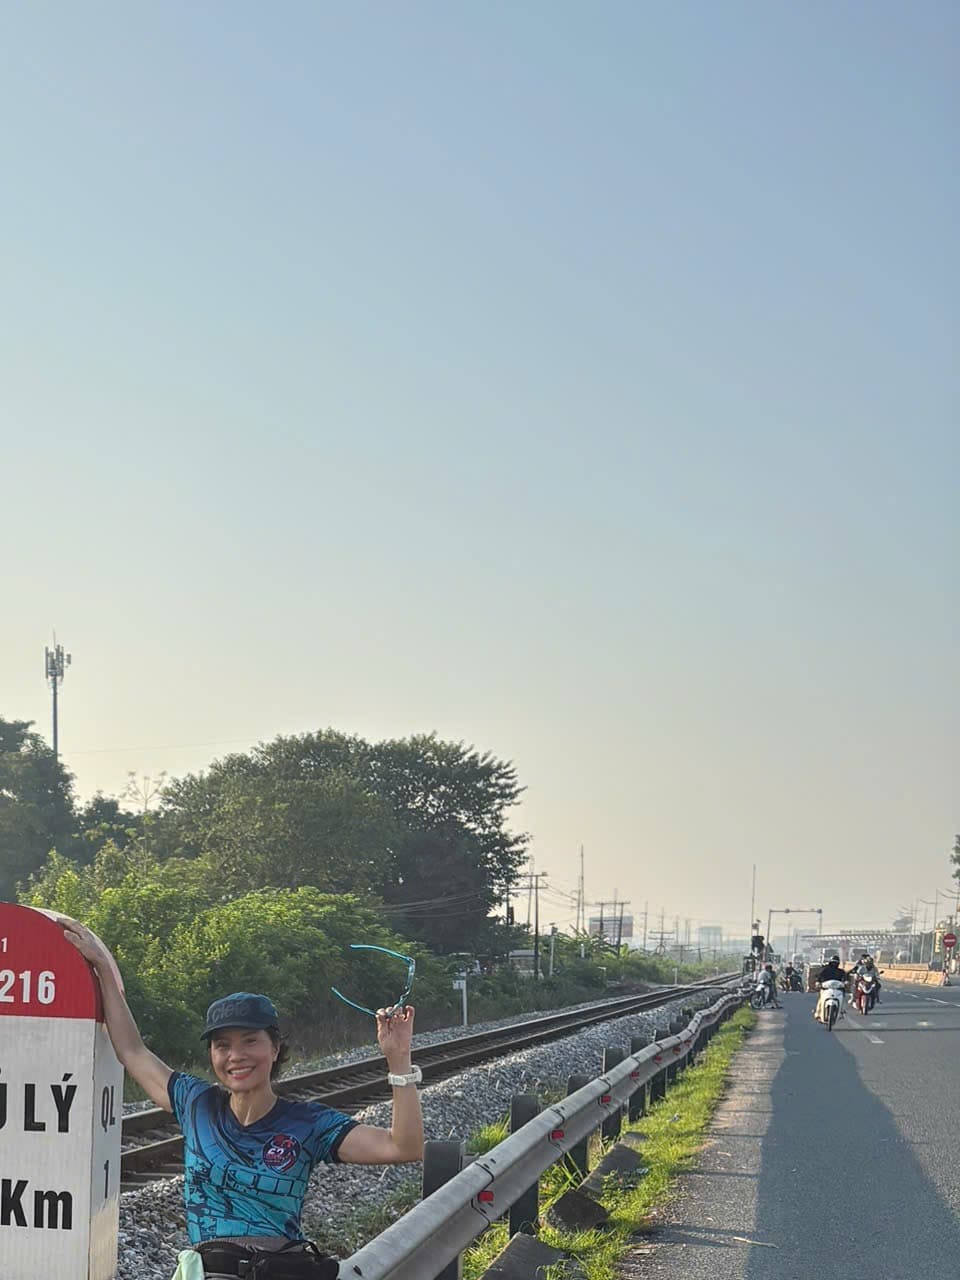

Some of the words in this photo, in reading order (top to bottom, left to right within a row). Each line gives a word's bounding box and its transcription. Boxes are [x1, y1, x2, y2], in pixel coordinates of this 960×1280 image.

[24, 1073, 78, 1133] LÝ
[101, 1085, 115, 1133] QL
[0, 1178, 73, 1230] Km
[103, 1159, 110, 1199] 1
